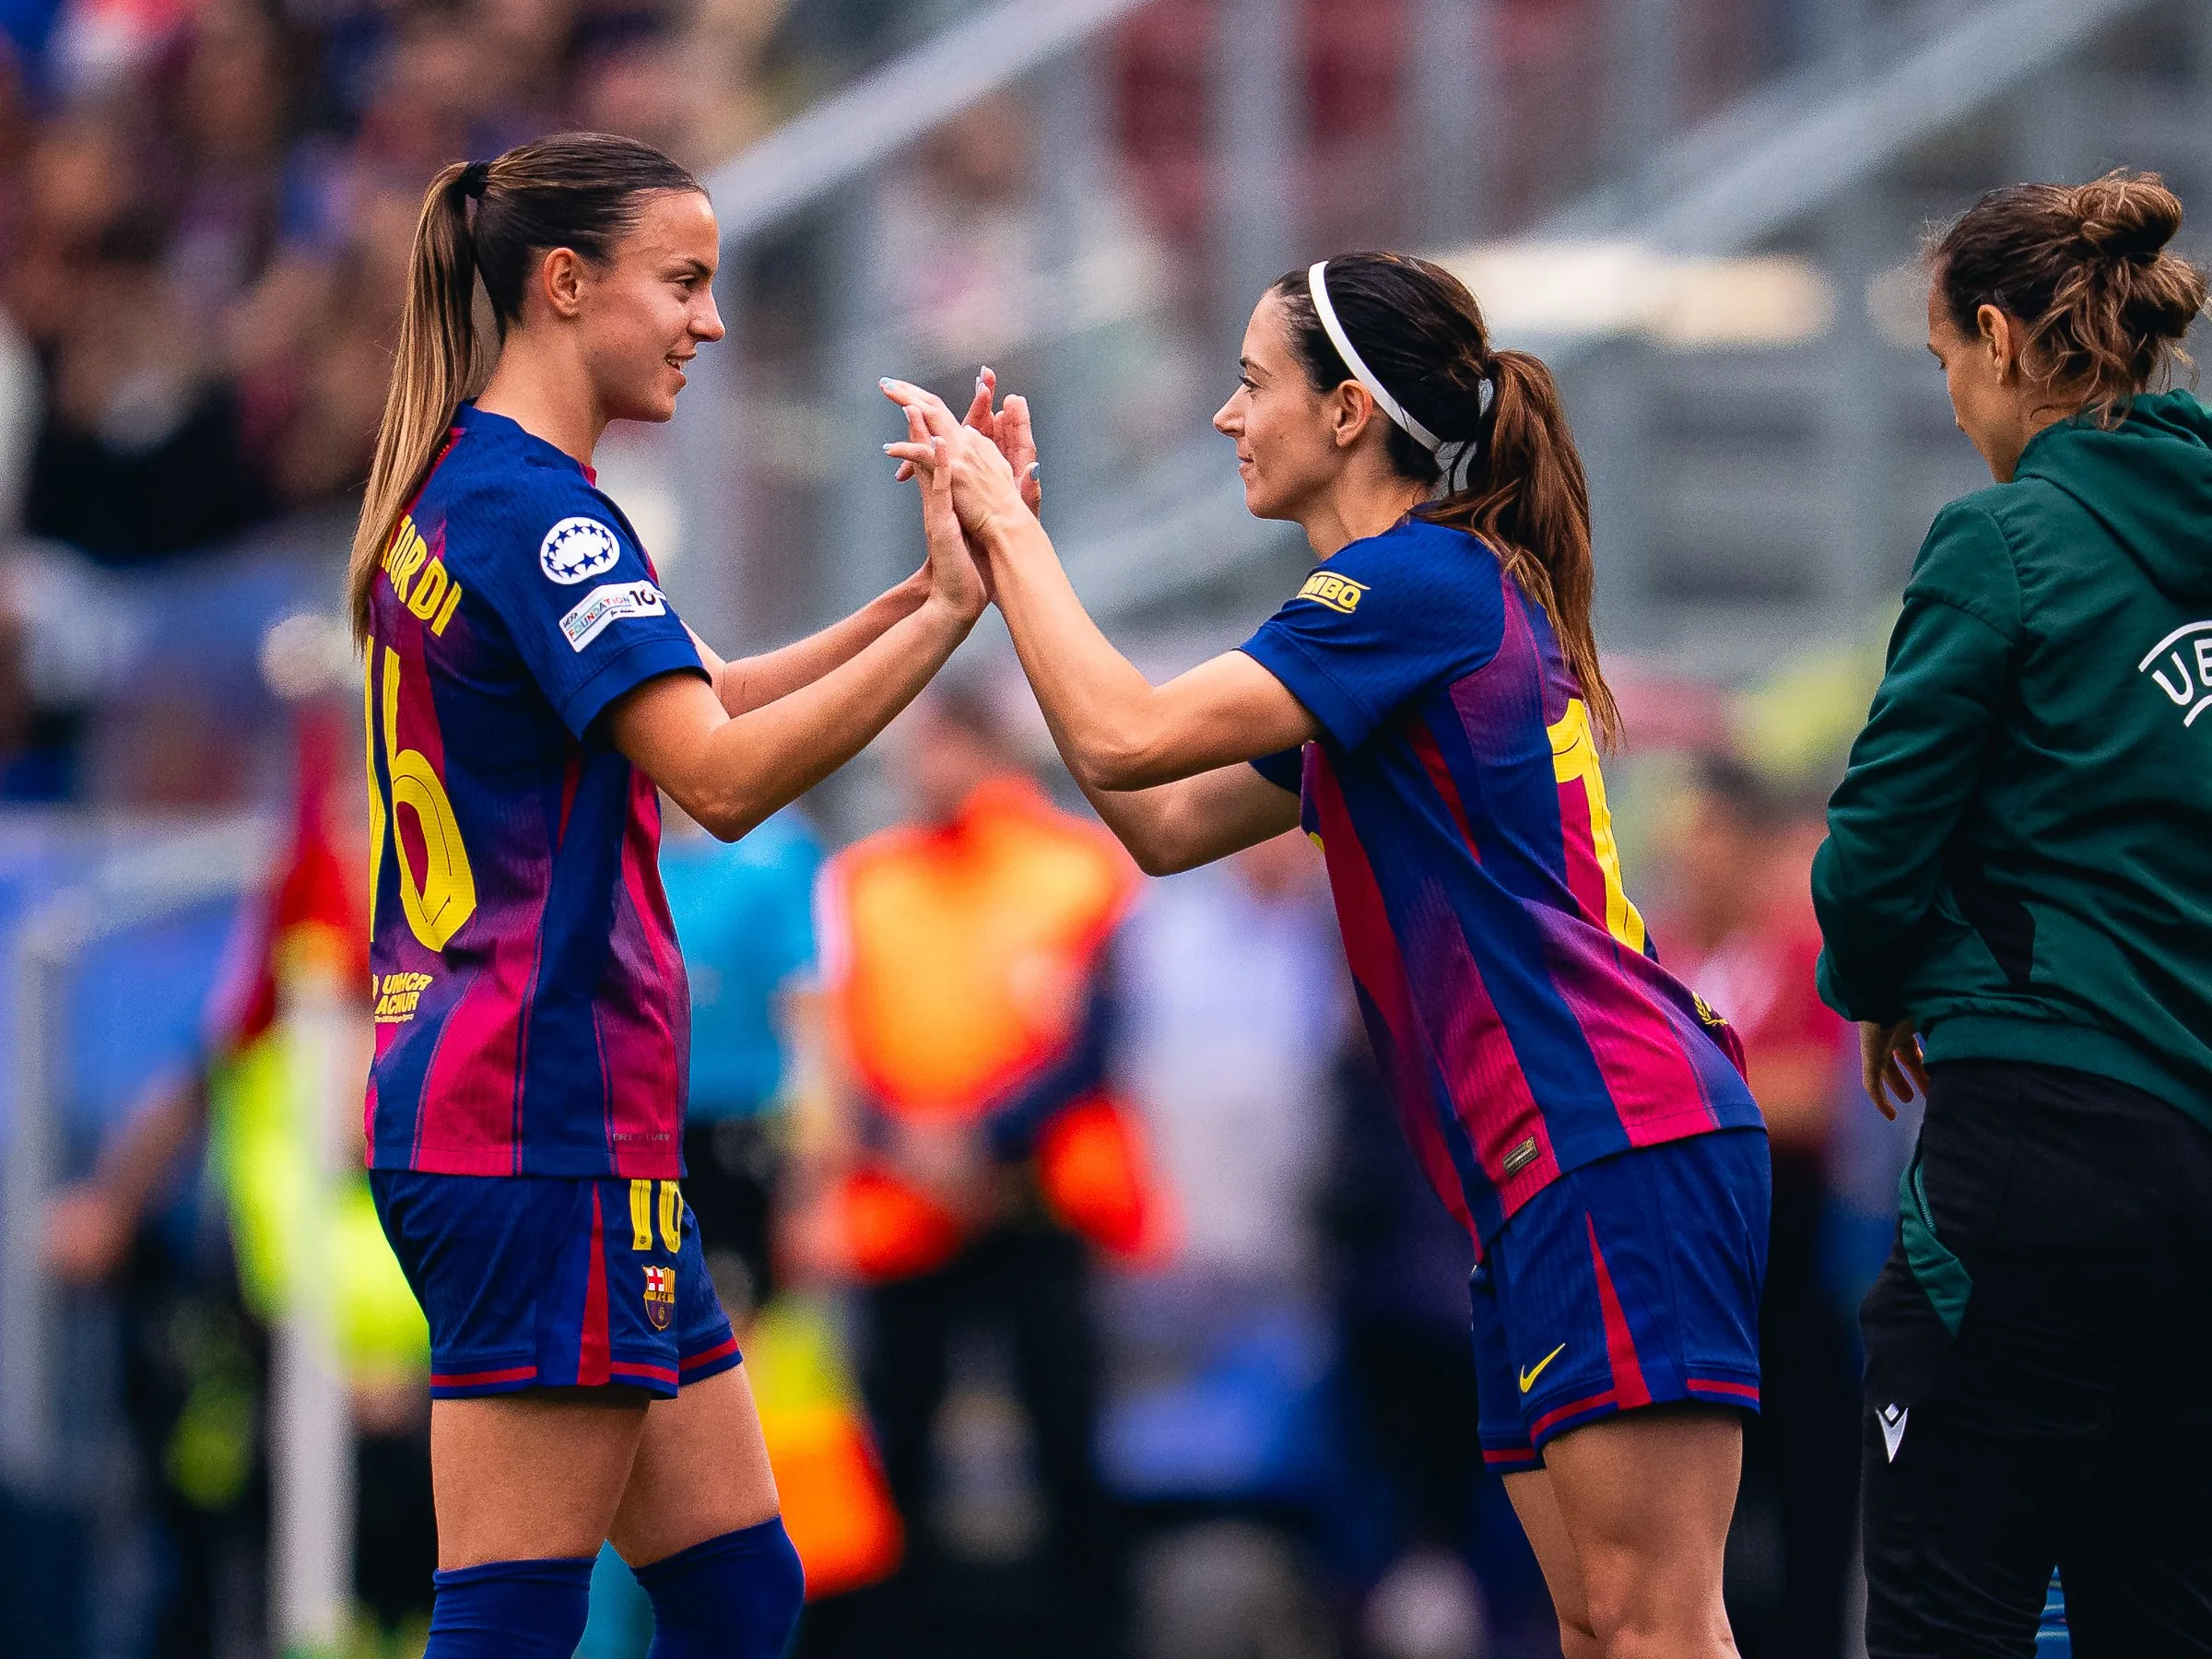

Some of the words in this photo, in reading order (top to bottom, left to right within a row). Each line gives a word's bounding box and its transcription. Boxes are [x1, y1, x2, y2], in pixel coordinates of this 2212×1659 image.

[1296, 576, 1361, 608] MBO
[569, 596, 631, 639] FOUNDATION
[382, 971, 433, 995] UNHCR
[374, 991, 420, 1015] ACNUR
